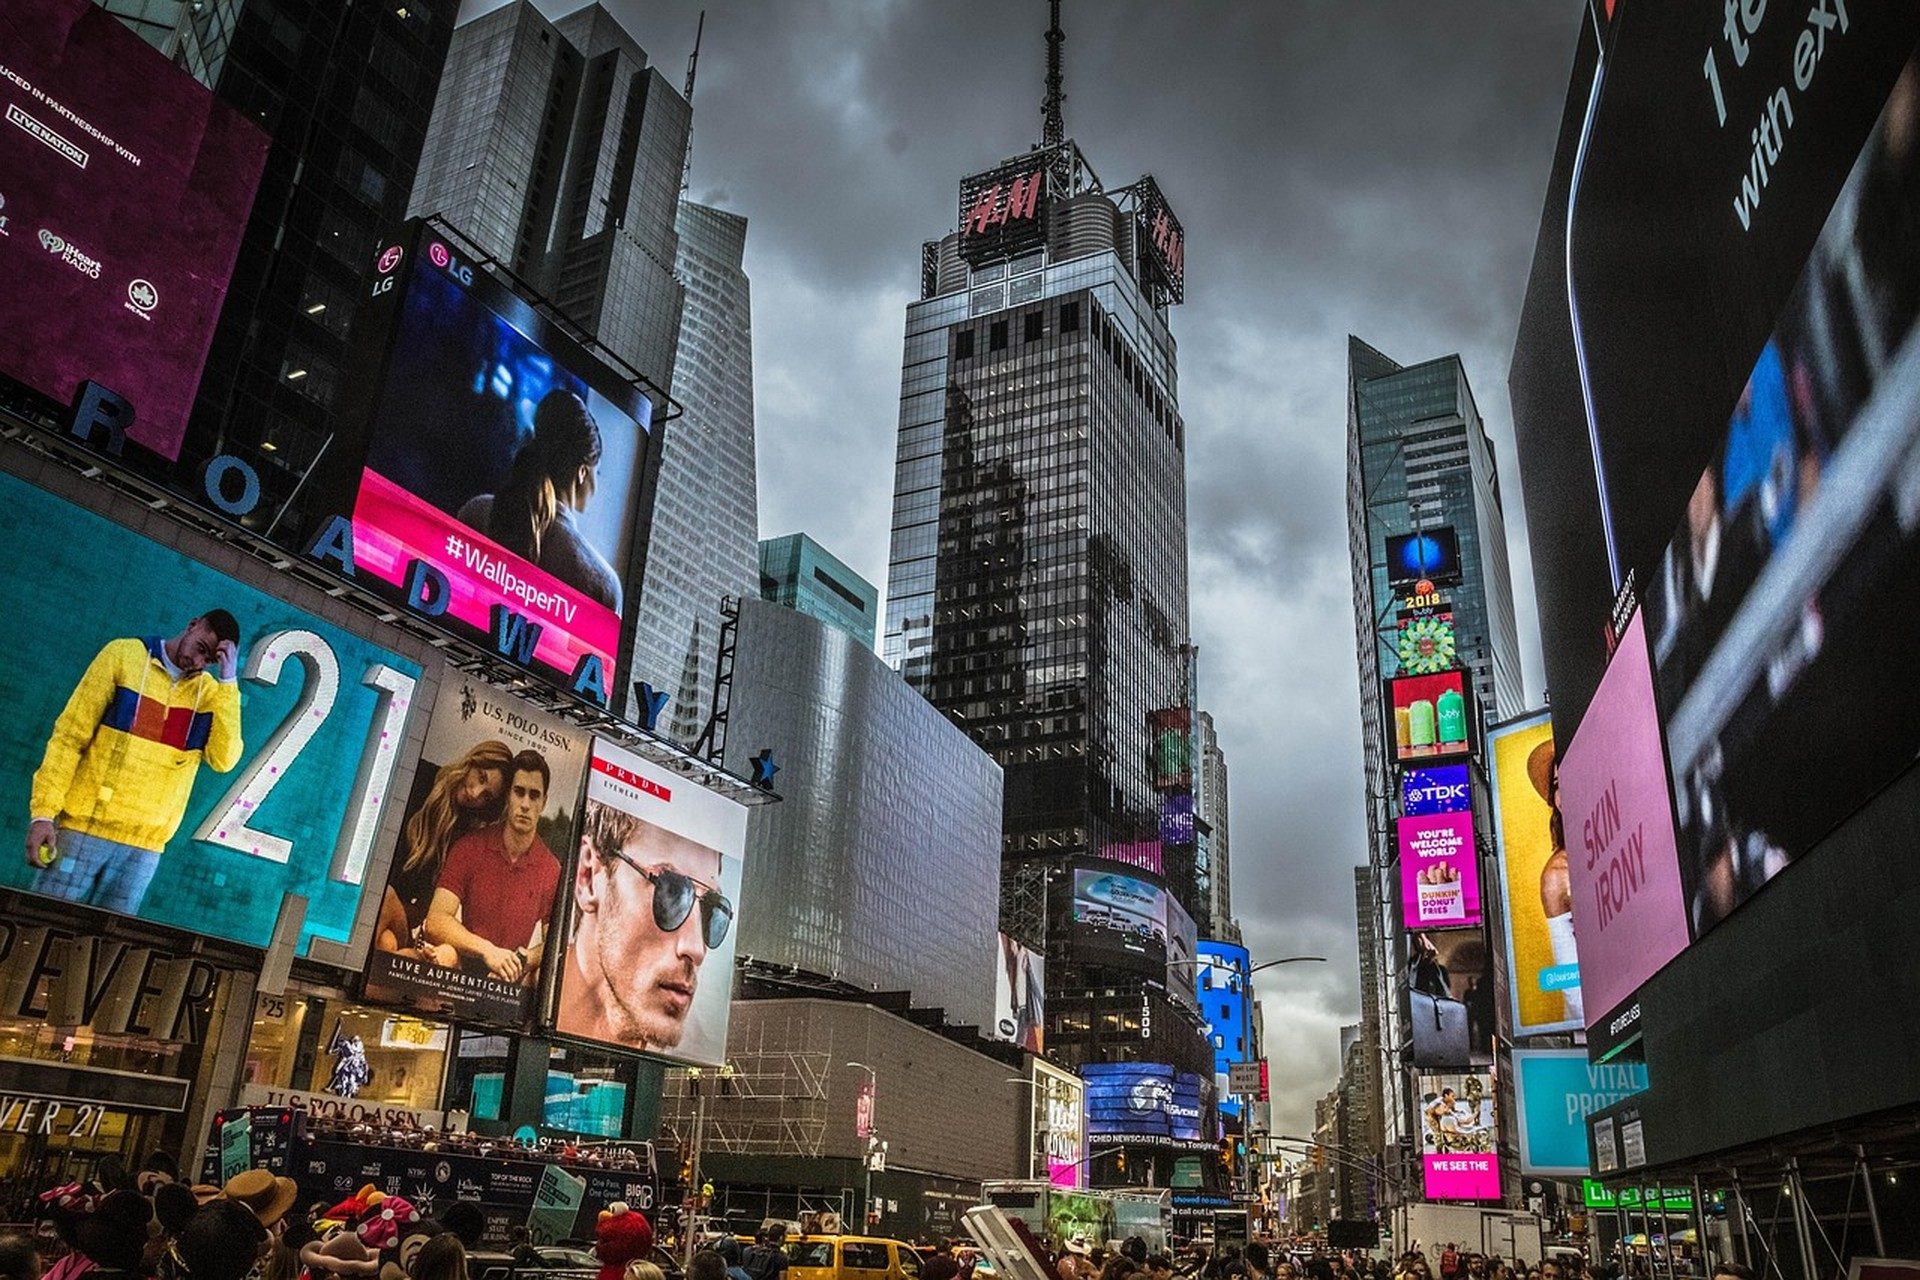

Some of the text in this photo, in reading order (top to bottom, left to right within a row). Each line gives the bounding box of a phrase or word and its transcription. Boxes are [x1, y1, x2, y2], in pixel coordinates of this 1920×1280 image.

[1703, 46, 1727, 128] 1
[32, 88, 45, 101] IN
[45, 97, 115, 147] PARTNERSHIP
[115, 143, 142, 167] WITH
[1733, 86, 1794, 232] with
[964, 170, 1042, 237] H&M
[62, 253, 100, 279] RADIO
[65, 243, 102, 272] iHeart
[449, 256, 473, 286] LG
[372, 277, 393, 297] LG
[445, 535, 577, 624] #WallpaperTV
[1406, 593, 1440, 608] 2018
[482, 702, 572, 752] U.S. POLO ASSN.
[499, 728, 524, 743] SINCE
[194, 630, 417, 885] 21
[604, 780, 639, 799] EYEWEAR
[606, 763, 661, 795] PRADA
[1422, 784, 1465, 801] TDK
[1417, 828, 1455, 840] YOU'RE
[1583, 780, 1621, 872] SKIN
[1410, 837, 1463, 850] WELCOME
[1418, 847, 1457, 858] WORLD
[1595, 822, 1647, 933] IRONY
[1421, 889, 1460, 900] DUNKIN'
[1422, 898, 1455, 907] DONUT
[1422, 906, 1448, 915] FRIES
[392, 958, 522, 998] LIVE AUTHENTICALLY
[260, 997, 285, 1018] $25
[1141, 995, 1150, 1038] 1500
[1587, 1064, 1641, 1090] VITAL
[69, 1104, 106, 1138] 21
[1566, 1093, 1633, 1126] PRO
[1112, 1135, 1155, 1144] NEWSCAST
[1432, 1161, 1489, 1171] WE SEE THE
[589, 1187, 620, 1200] One Great
[592, 1178, 605, 1188] One
[626, 1183, 642, 1197] BIG
[626, 1196, 642, 1209] BUS
